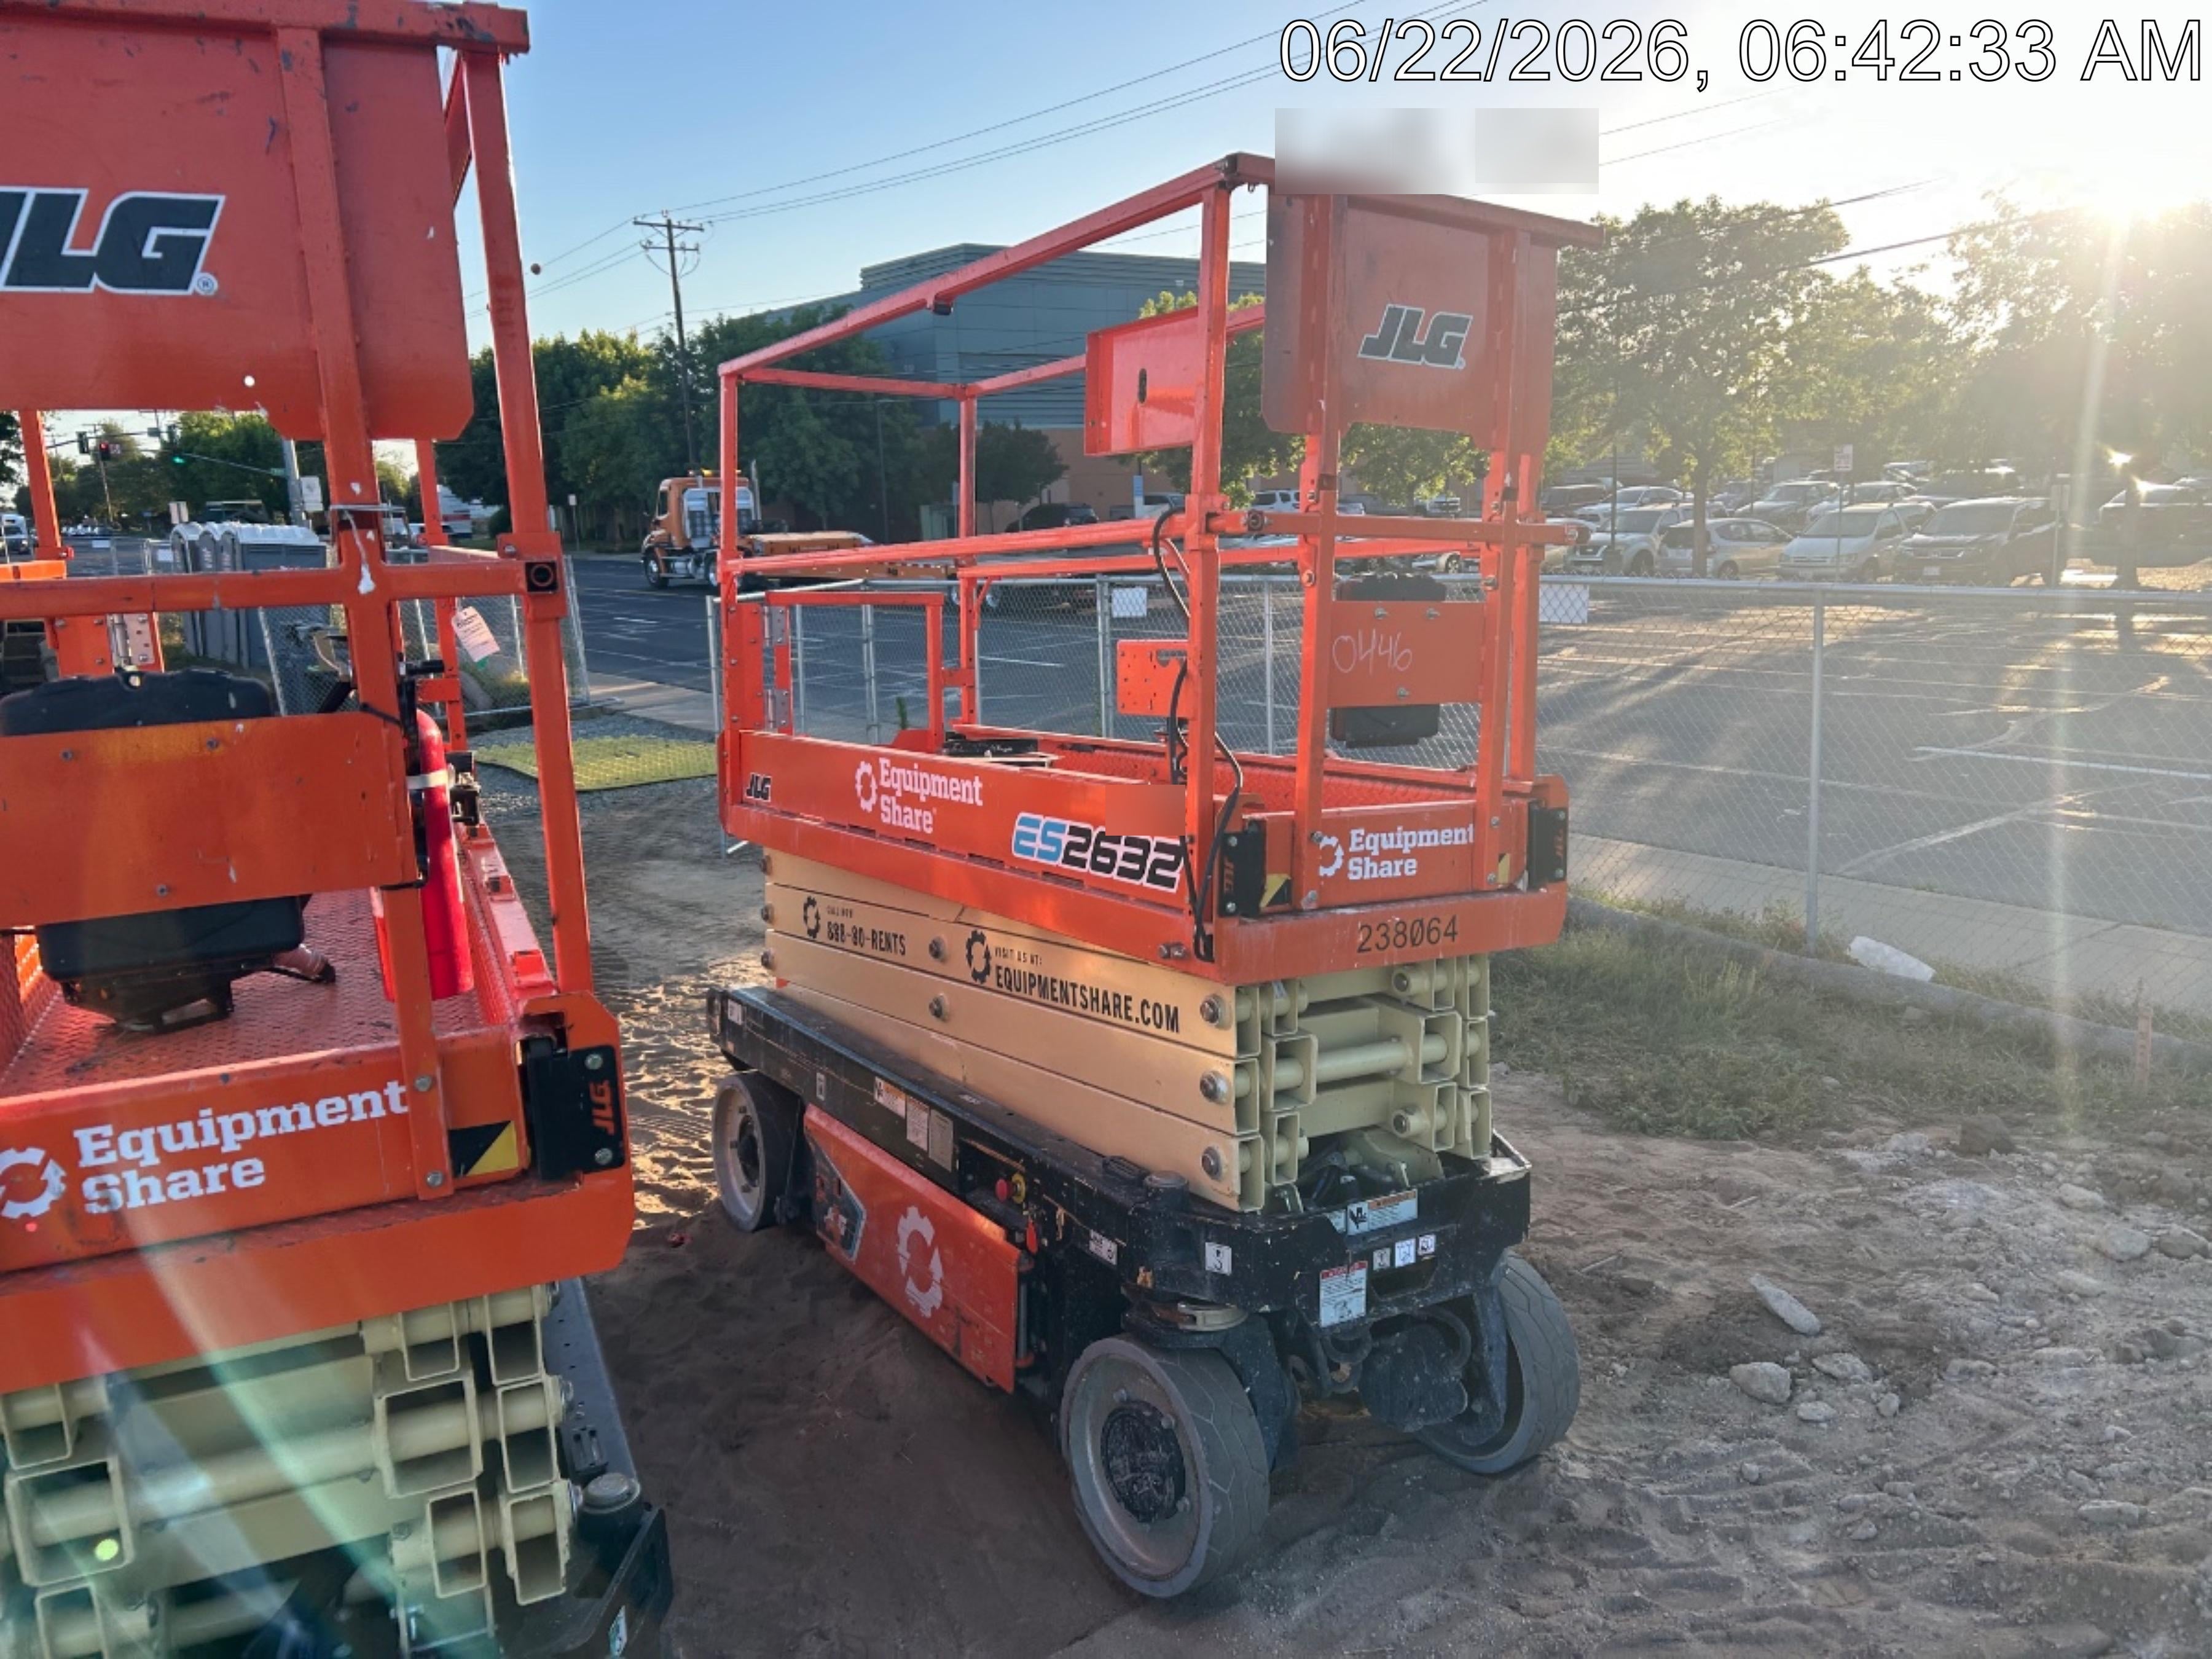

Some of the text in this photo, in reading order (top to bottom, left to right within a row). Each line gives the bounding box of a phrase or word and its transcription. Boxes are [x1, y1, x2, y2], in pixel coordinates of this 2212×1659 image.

[0, 186, 226, 295] LG
[1357, 304, 1473, 369] JLG
[1332, 628, 1413, 675] 0446
[746, 772, 772, 802] JLG
[879, 757, 983, 806] Equipment
[880, 793, 933, 834] Share
[1348, 823, 1474, 856] Equipment
[1012, 812, 1185, 893] ES2632
[1347, 857, 1418, 880] Share
[1356, 914, 1457, 954] 238064
[995, 965, 1180, 1033] EQUIPMENTSHARE.COM
[73, 1080, 410, 1169] Equipment
[588, 1078, 616, 1136] JLG
[81, 1156, 265, 1215] Share
